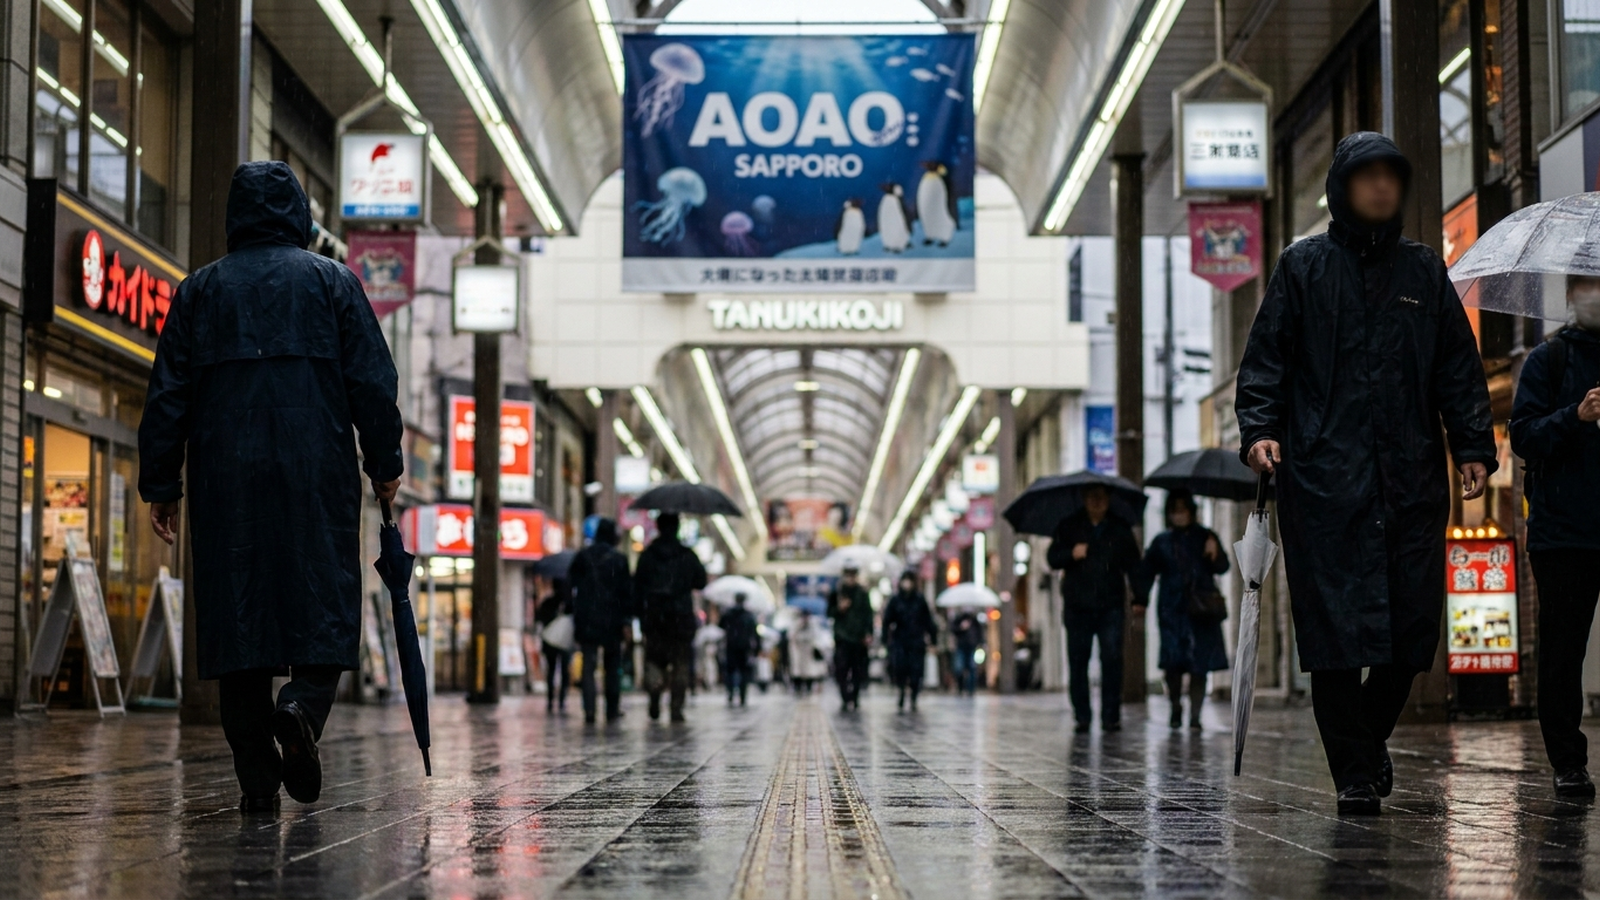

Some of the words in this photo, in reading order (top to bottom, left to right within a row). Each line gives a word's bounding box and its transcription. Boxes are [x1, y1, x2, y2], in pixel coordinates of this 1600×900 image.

[688, 91, 905, 147] AOAO
[734, 153, 863, 178] SAPPORO
[707, 300, 904, 330] TANUKIKOJI
